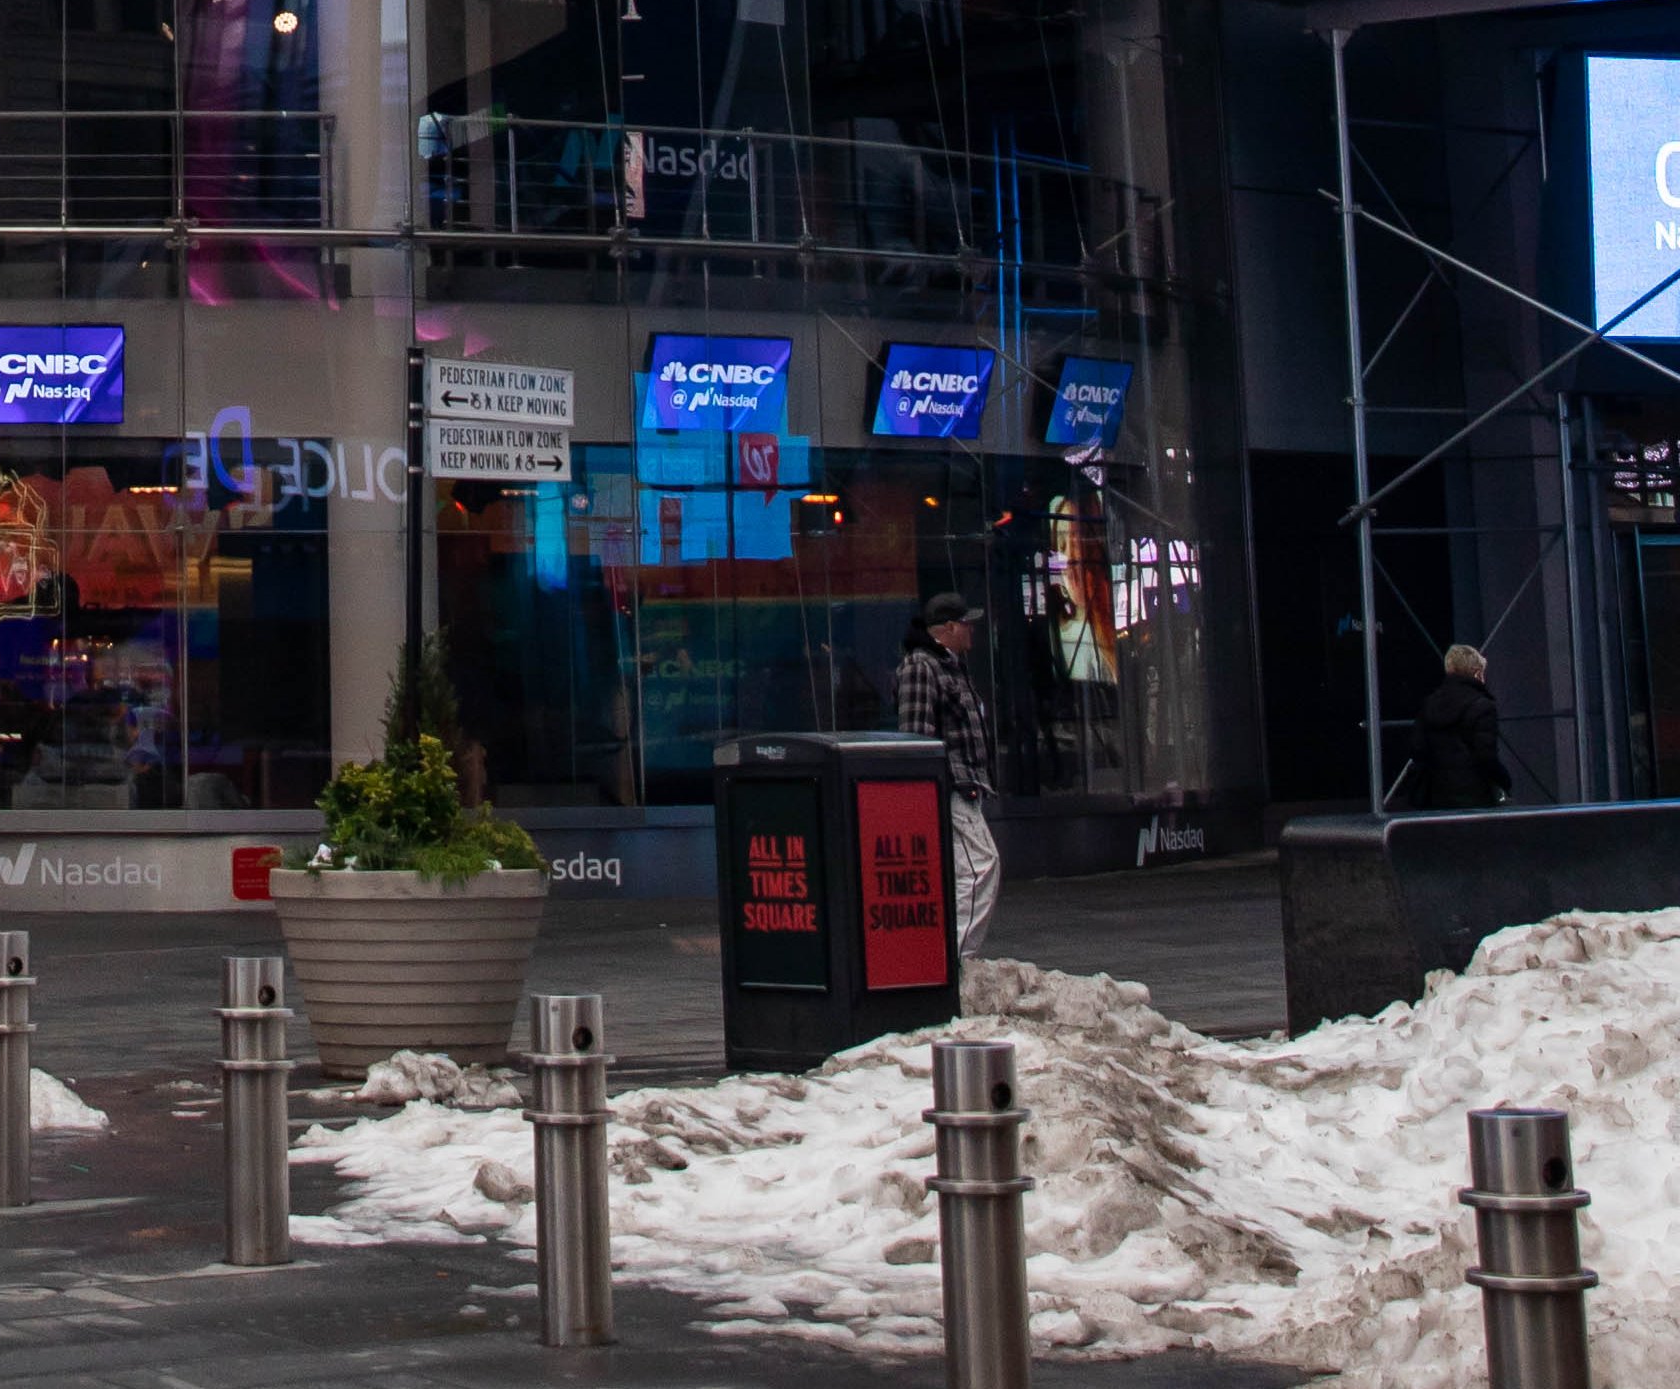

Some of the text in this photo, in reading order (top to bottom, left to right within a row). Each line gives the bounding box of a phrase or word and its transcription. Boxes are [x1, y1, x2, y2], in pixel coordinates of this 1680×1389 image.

[439, 365, 566, 394] PEDESTRIAN FLOW ZONE
[688, 363, 775, 386] CNBC
[913, 371, 979, 394] CNBC
[32, 382, 91, 402] Nasdaq
[712, 392, 758, 410] Nasdaq
[497, 394, 567, 417] KEEP MOVING
[928, 400, 965, 418] Nasdaq
[439, 427, 564, 450] PEDESTRIAN FLOW ZONE
[440, 451, 510, 471] KEEP MOVING
[748, 834, 805, 860] ALL IN
[873, 833, 928, 860] ALL IN
[1160, 818, 1205, 854] Nasdaq
[40, 849, 163, 889] Nasdaq
[551, 851, 622, 888] sdaq
[749, 870, 808, 898] TIMES
[875, 869, 930, 897] TIMES
[743, 901, 818, 932] SQUARE
[868, 901, 939, 930] SQUARE
